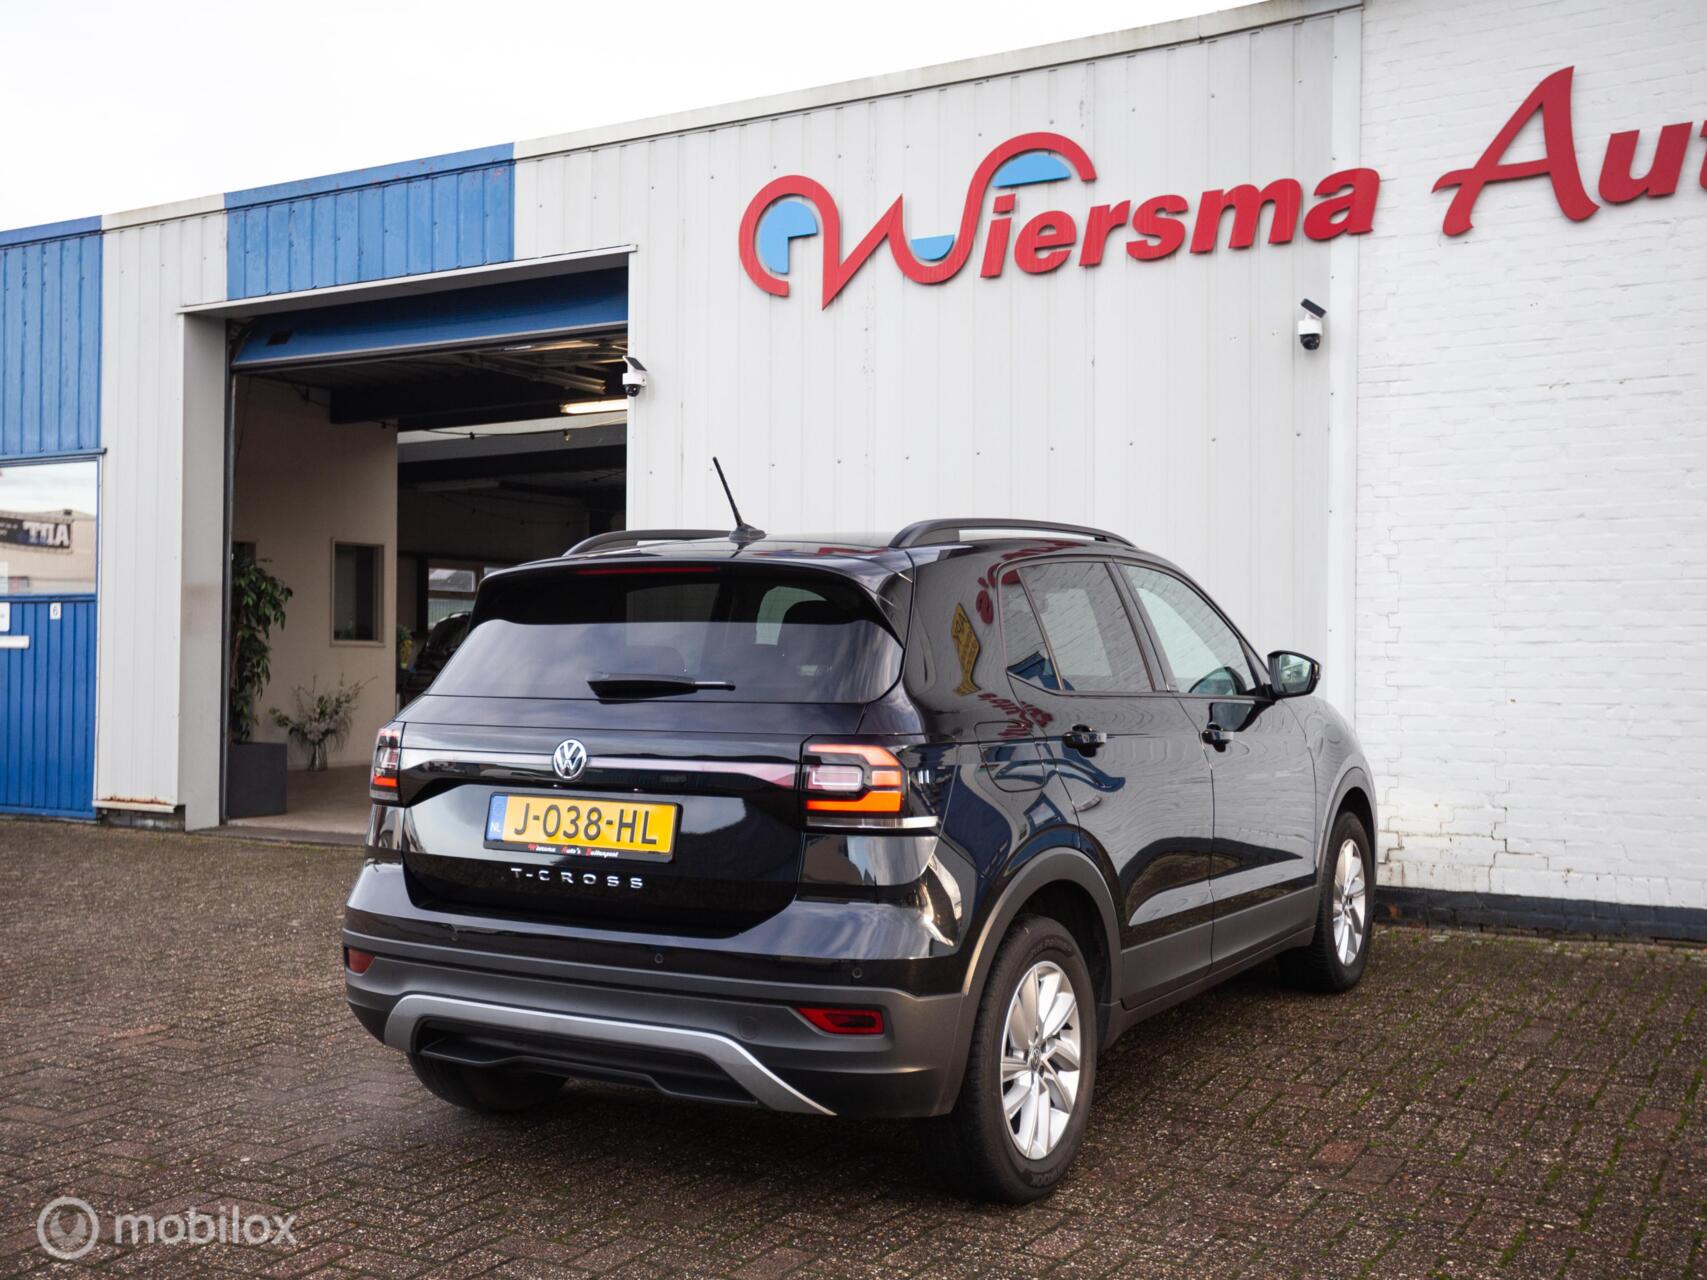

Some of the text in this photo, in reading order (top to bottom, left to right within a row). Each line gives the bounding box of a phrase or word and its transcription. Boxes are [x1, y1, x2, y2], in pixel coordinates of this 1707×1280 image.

[740, 66, 1707, 310] Wiersma Au
[514, 802, 657, 845] J-038-HL
[510, 867, 643, 889] T-CROSS
